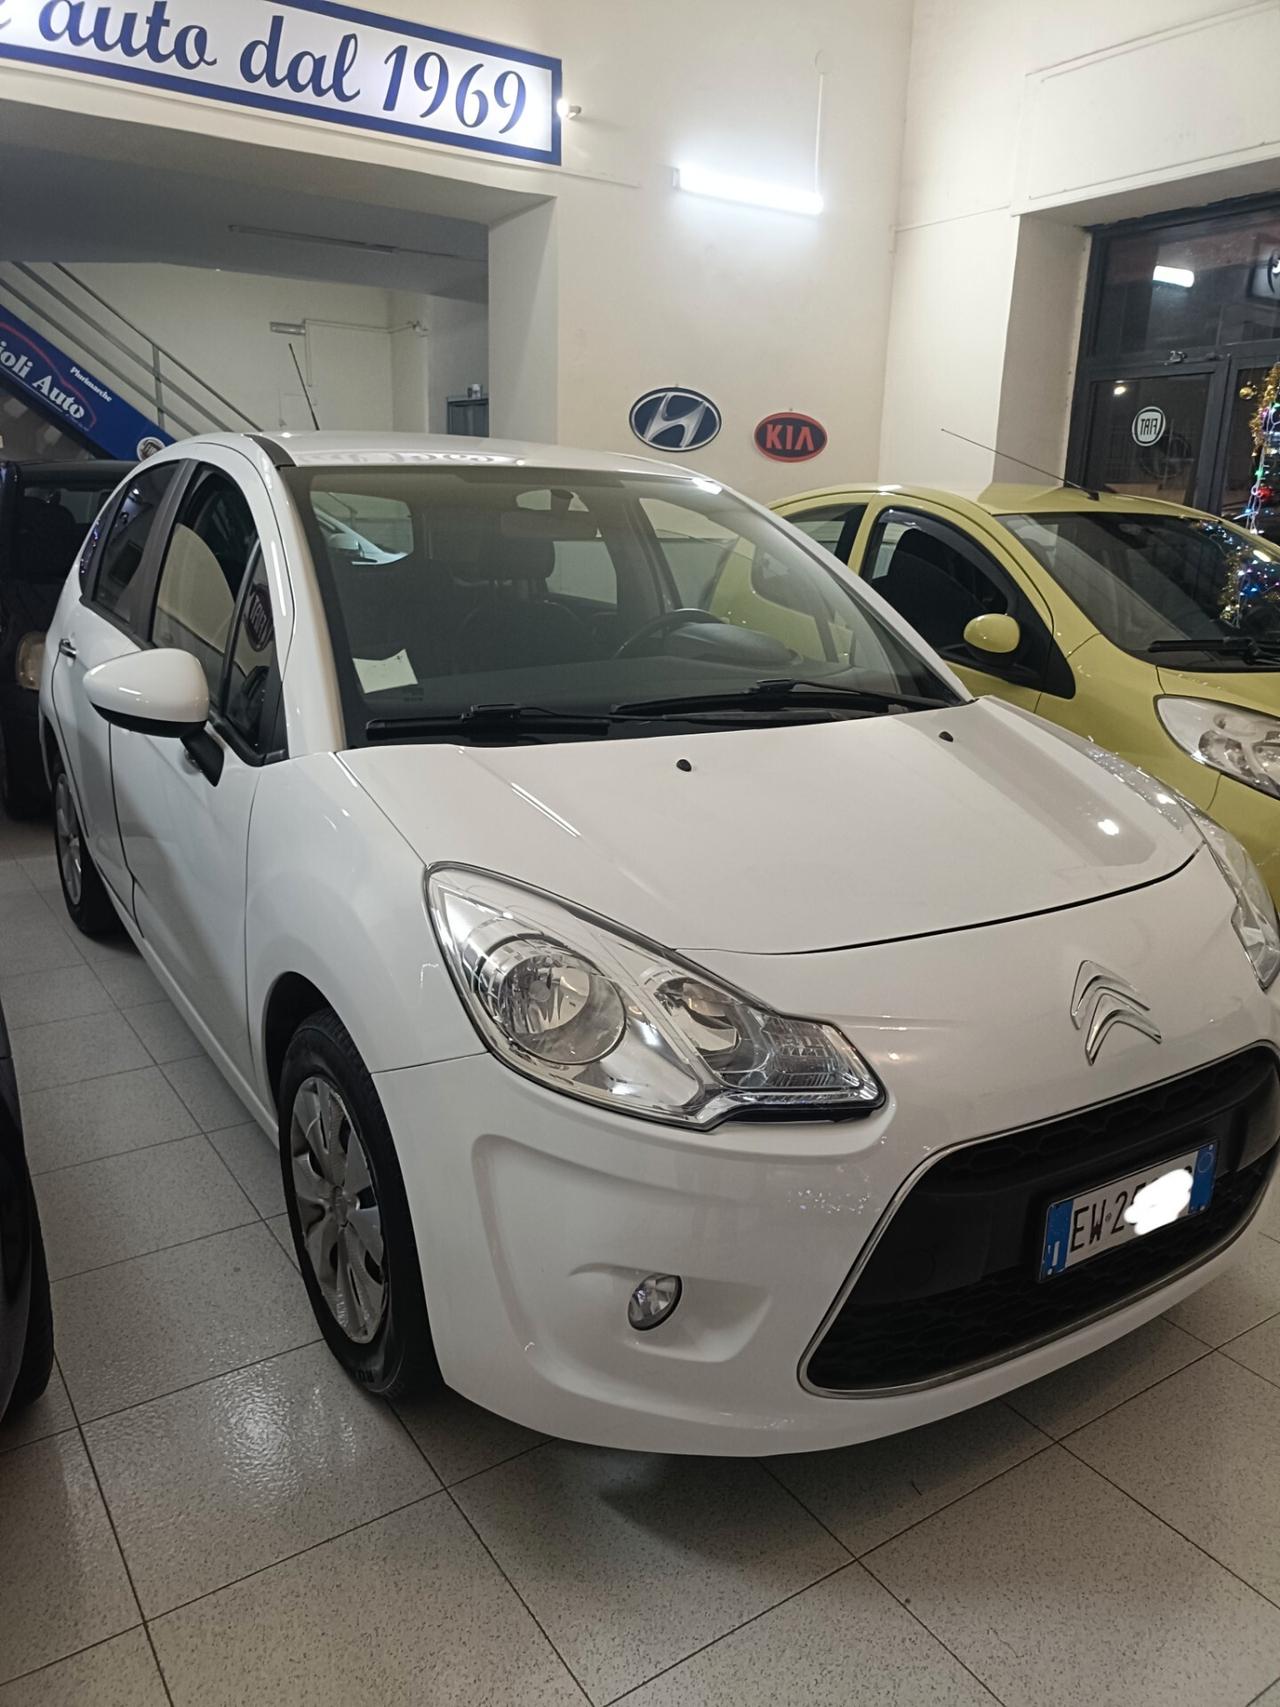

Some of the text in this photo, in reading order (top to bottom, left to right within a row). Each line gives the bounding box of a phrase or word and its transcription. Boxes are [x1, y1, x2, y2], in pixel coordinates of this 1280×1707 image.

[39, 0, 526, 134] auto dal 1969
[32, 375, 85, 419] Auto
[765, 423, 815, 452] KIA
